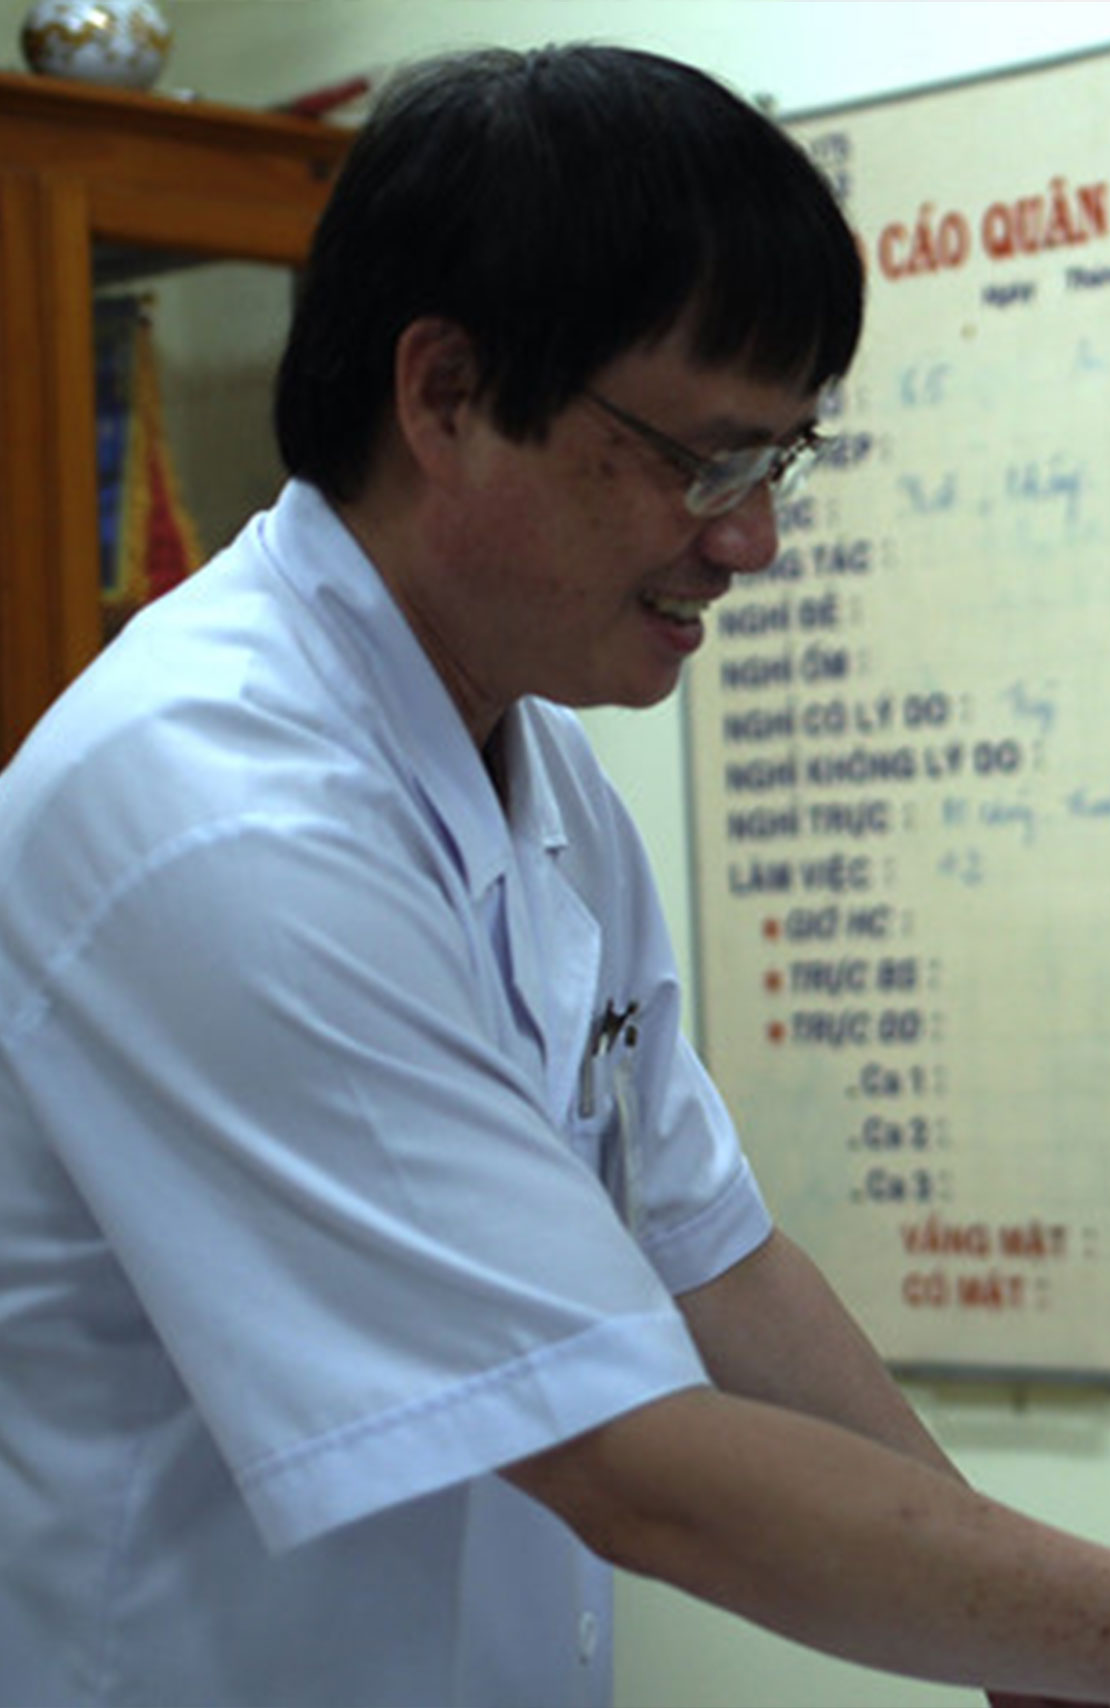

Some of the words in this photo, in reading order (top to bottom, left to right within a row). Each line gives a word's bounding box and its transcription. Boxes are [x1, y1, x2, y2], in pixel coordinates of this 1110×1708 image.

[877, 200, 970, 279] CÁO
[981, 176, 1109, 260] QUÂN
[910, 1117, 928, 1150] 2
